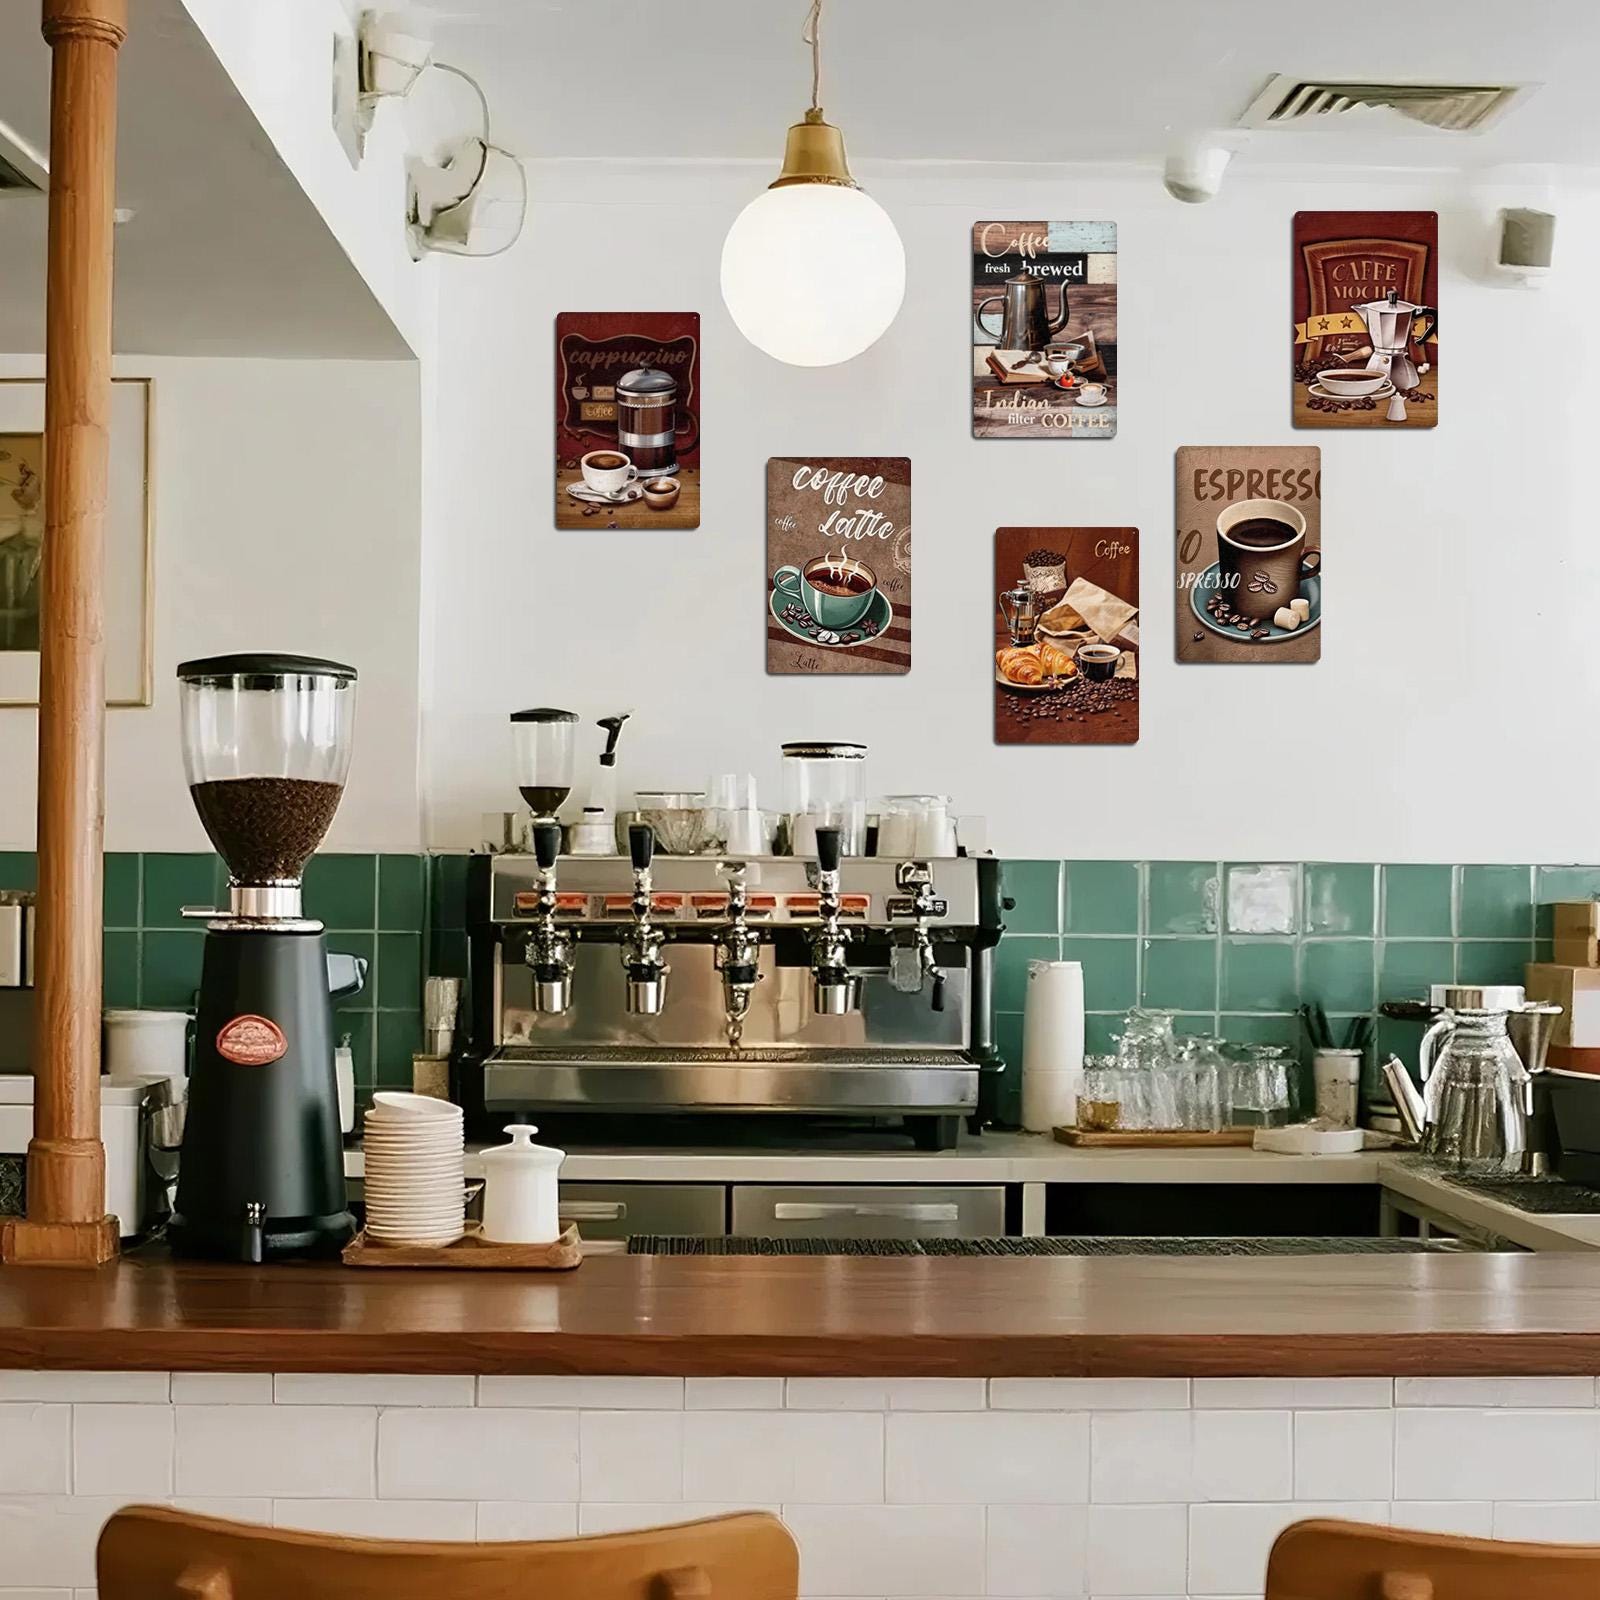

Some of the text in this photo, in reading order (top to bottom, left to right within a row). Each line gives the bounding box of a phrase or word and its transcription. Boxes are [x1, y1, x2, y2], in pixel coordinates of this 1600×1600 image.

[985, 263, 1011, 273] fresh
[569, 348, 688, 369] cappuccino
[984, 389, 1050, 410] Indian
[1008, 413, 1110, 428] filter COFFEE
[792, 465, 887, 505] Coffee
[1193, 468, 1321, 501] ESPRESS
[775, 514, 798, 531] coffee
[818, 508, 895, 540] Latte
[1095, 540, 1131, 559] Coffee
